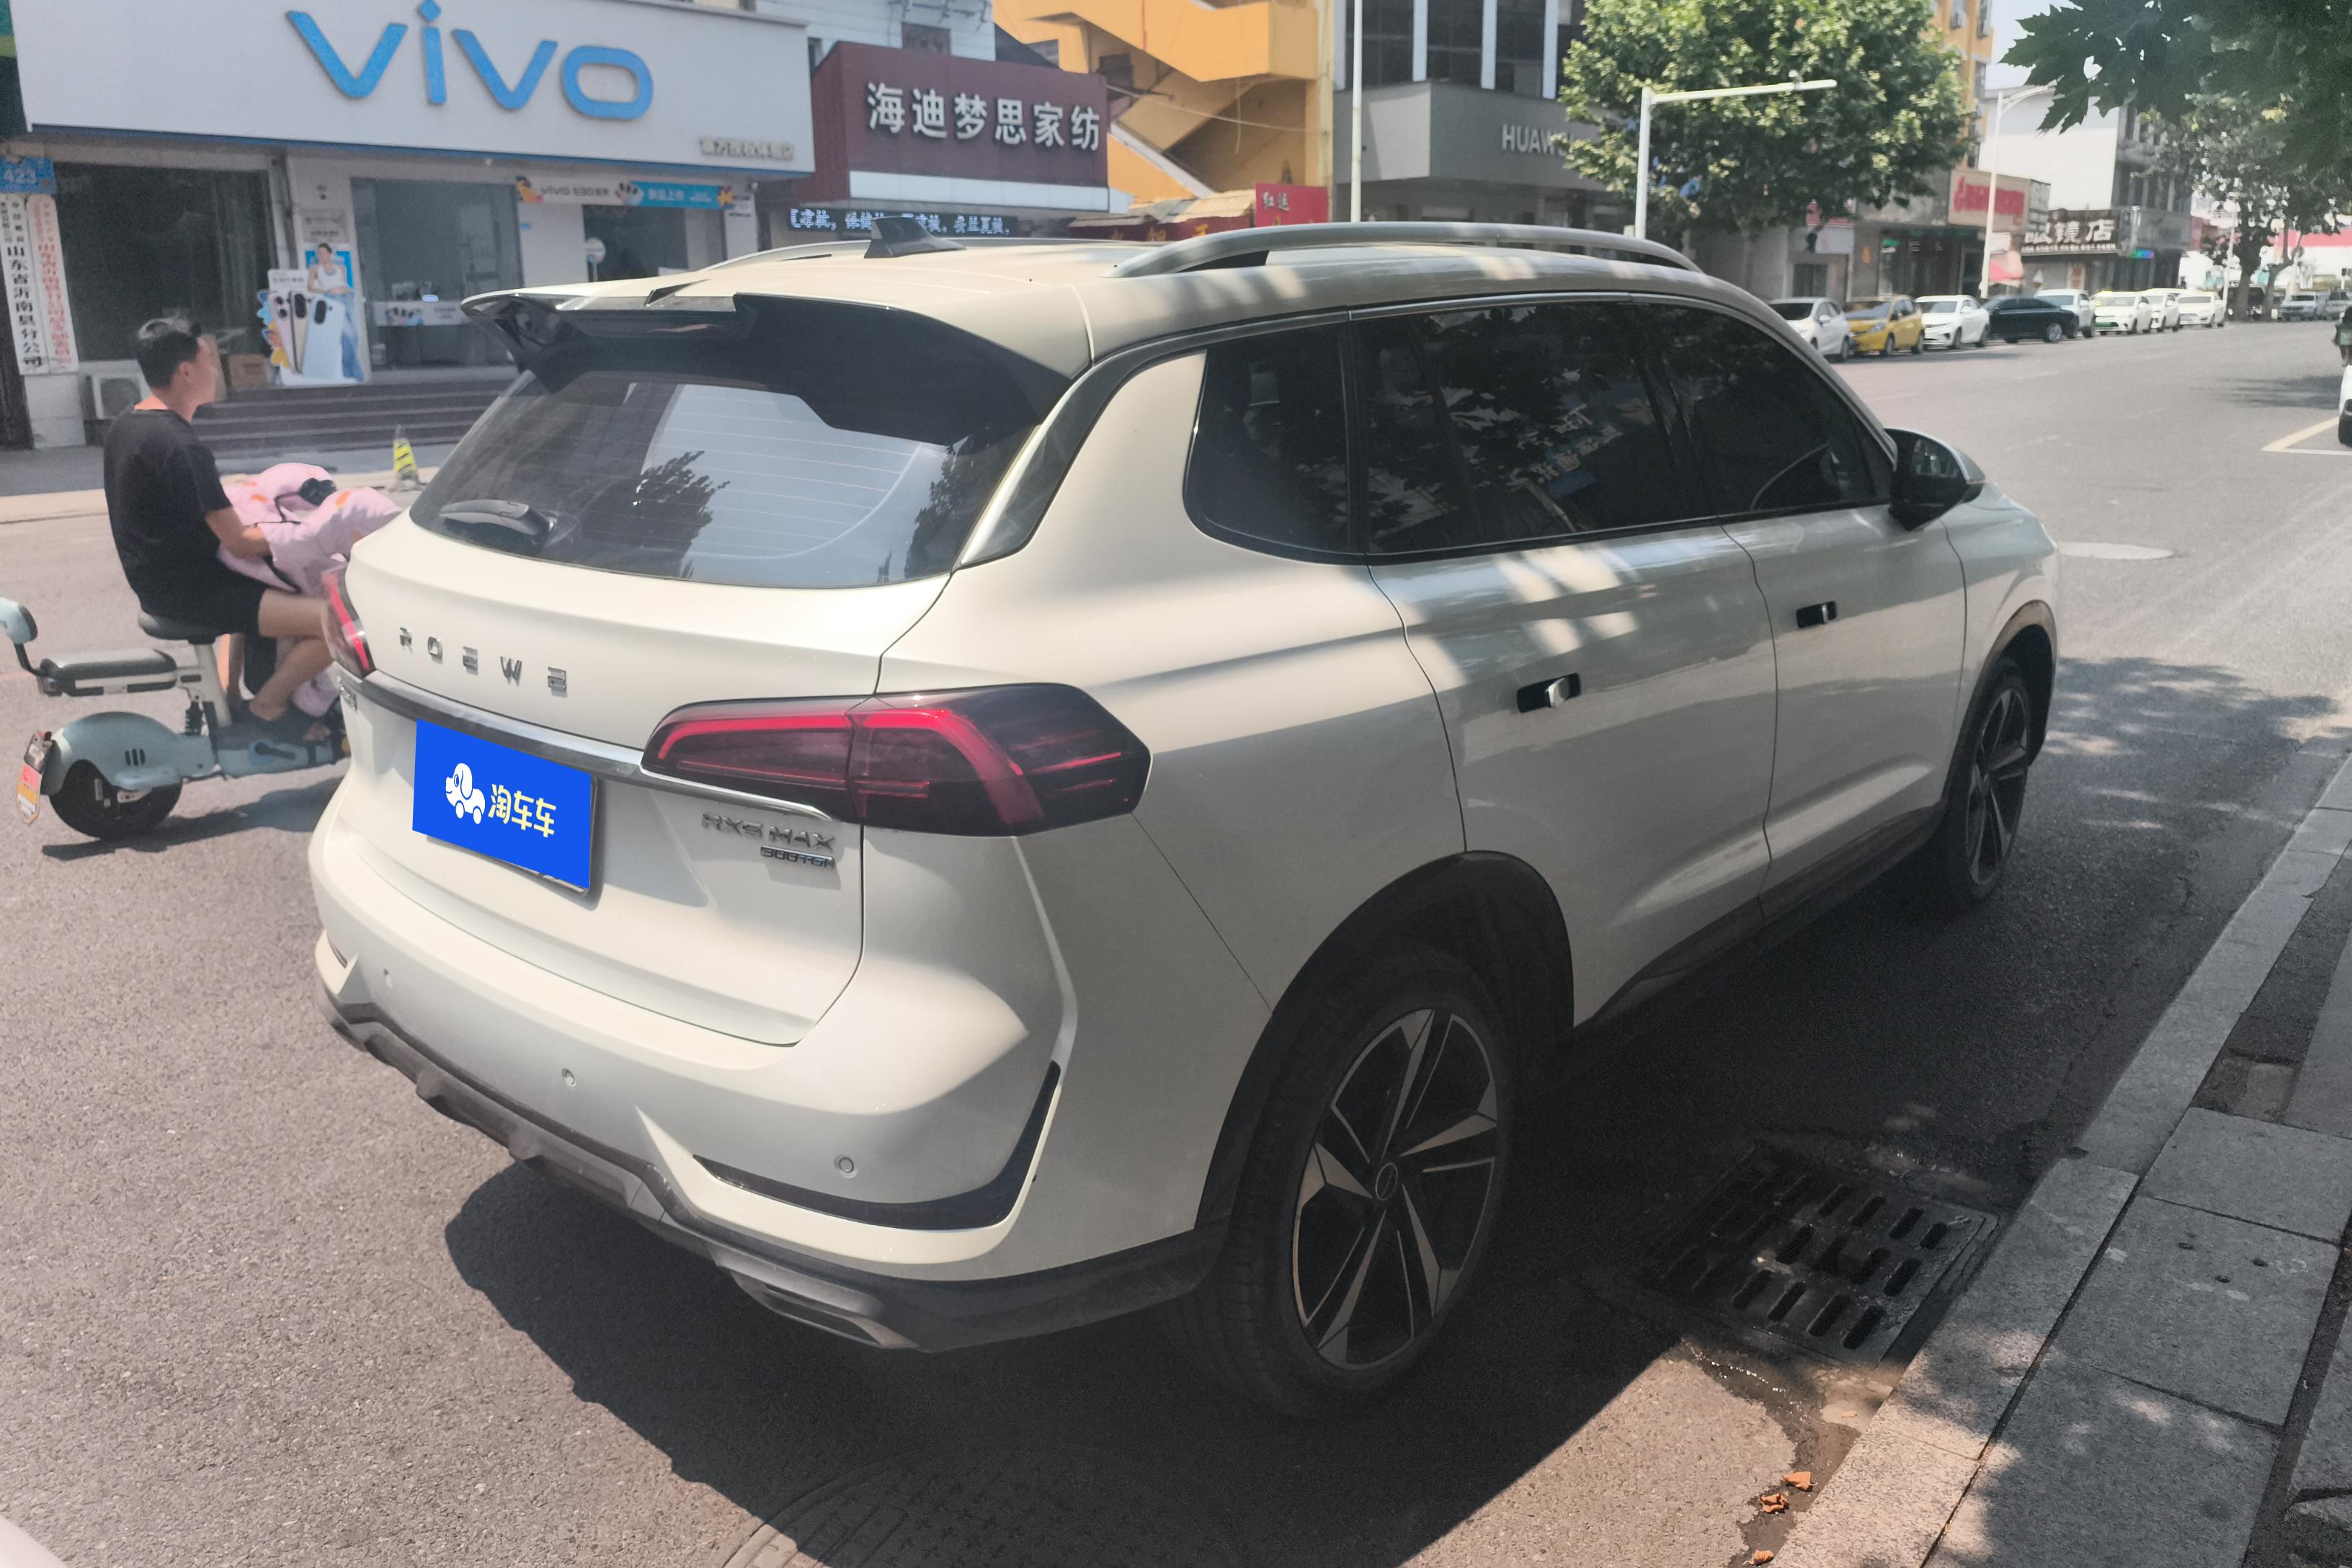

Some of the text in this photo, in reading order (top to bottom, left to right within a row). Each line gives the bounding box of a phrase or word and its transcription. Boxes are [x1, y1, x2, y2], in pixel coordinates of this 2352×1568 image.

[285, 0, 654, 120] vivo
[867, 81, 1100, 151] 海迪梦思家纺
[399, 627, 567, 692] ROEWE
[701, 811, 836, 852] RX5 MAX
